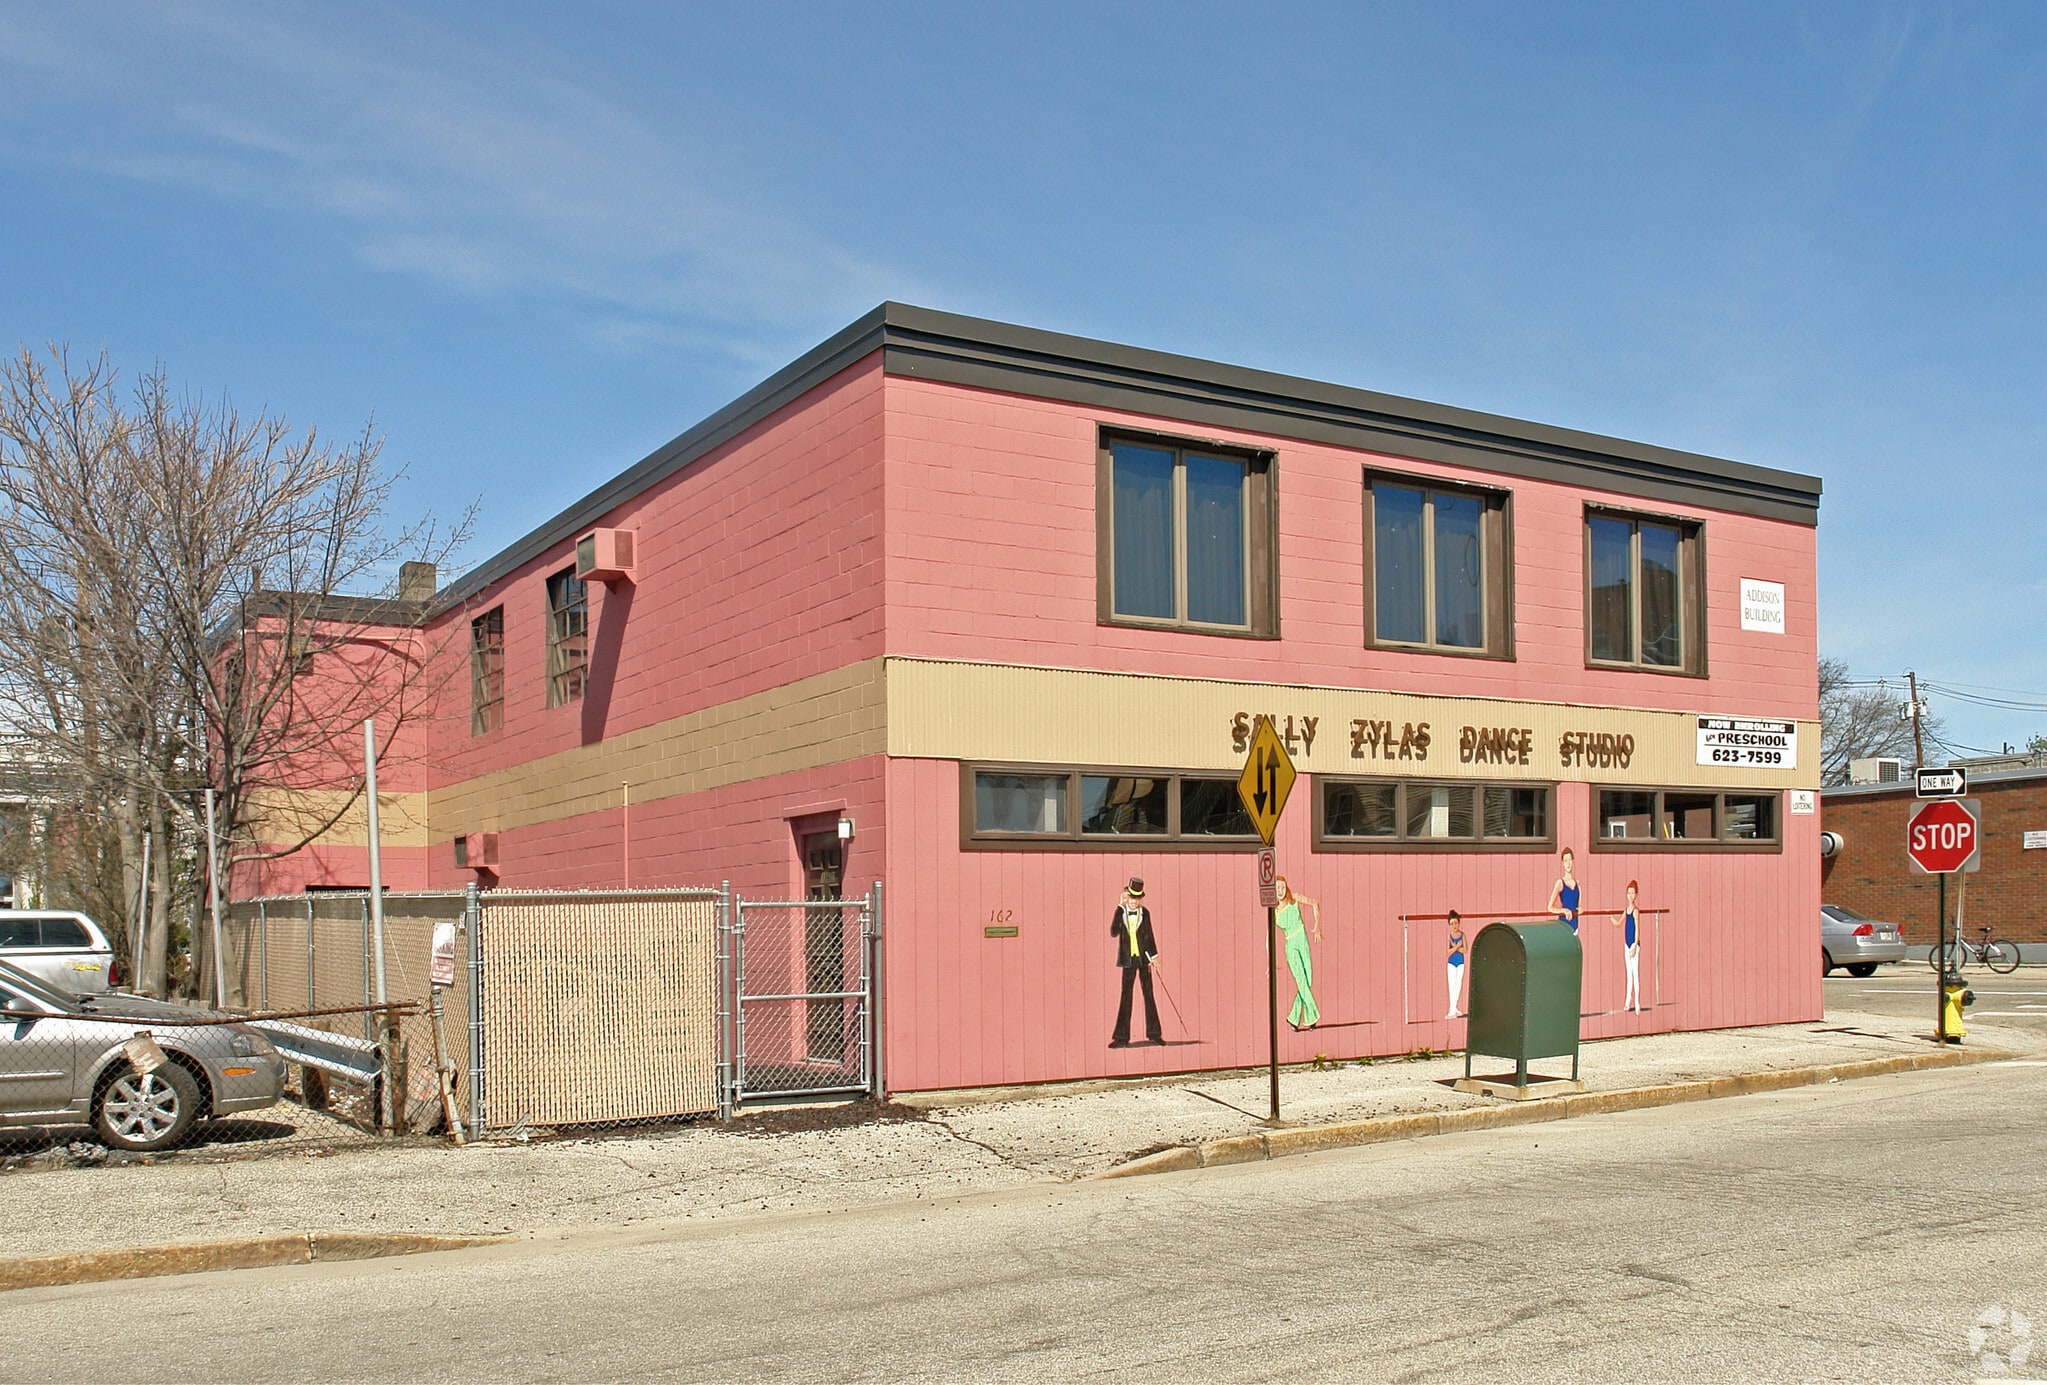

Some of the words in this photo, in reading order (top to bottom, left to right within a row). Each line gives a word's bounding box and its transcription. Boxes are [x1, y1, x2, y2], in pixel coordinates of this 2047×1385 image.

[1746, 589, 1780, 605] ADDISON
[1745, 607, 1781, 623] BUILDING
[1707, 720, 1731, 730] NOW
[1734, 721, 1786, 733] ENROLLING
[1353, 719, 1431, 746] ZYLAS
[1462, 726, 1533, 752] DANCE
[1562, 731, 1635, 756] STUDIO
[1718, 732, 1788, 746] PRESCHOOL
[1712, 749, 1782, 764] 623-7599
[1922, 777, 1937, 788] ONE
[1940, 776, 1956, 787] WAY
[1912, 822, 1971, 851] STOP
[990, 909, 1012, 923] 162
